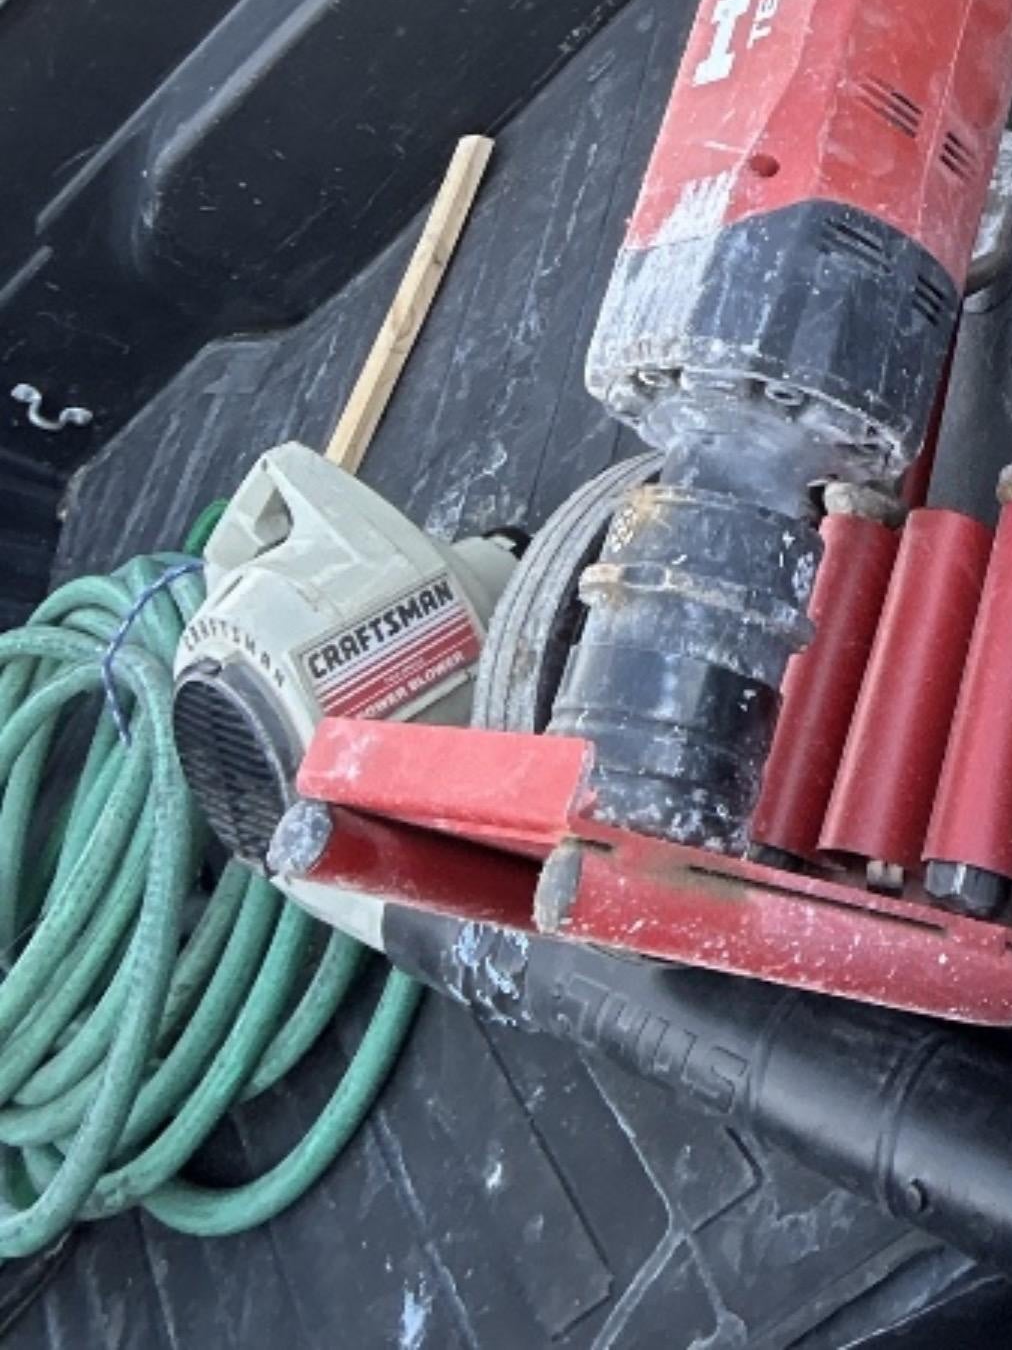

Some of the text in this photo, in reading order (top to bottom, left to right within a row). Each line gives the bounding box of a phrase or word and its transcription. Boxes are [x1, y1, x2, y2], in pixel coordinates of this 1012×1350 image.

[184, 616, 286, 689] CRAFTSMAN
[307, 580, 455, 680] CRAFTSMAN
[406, 650, 465, 691] BLOWER
